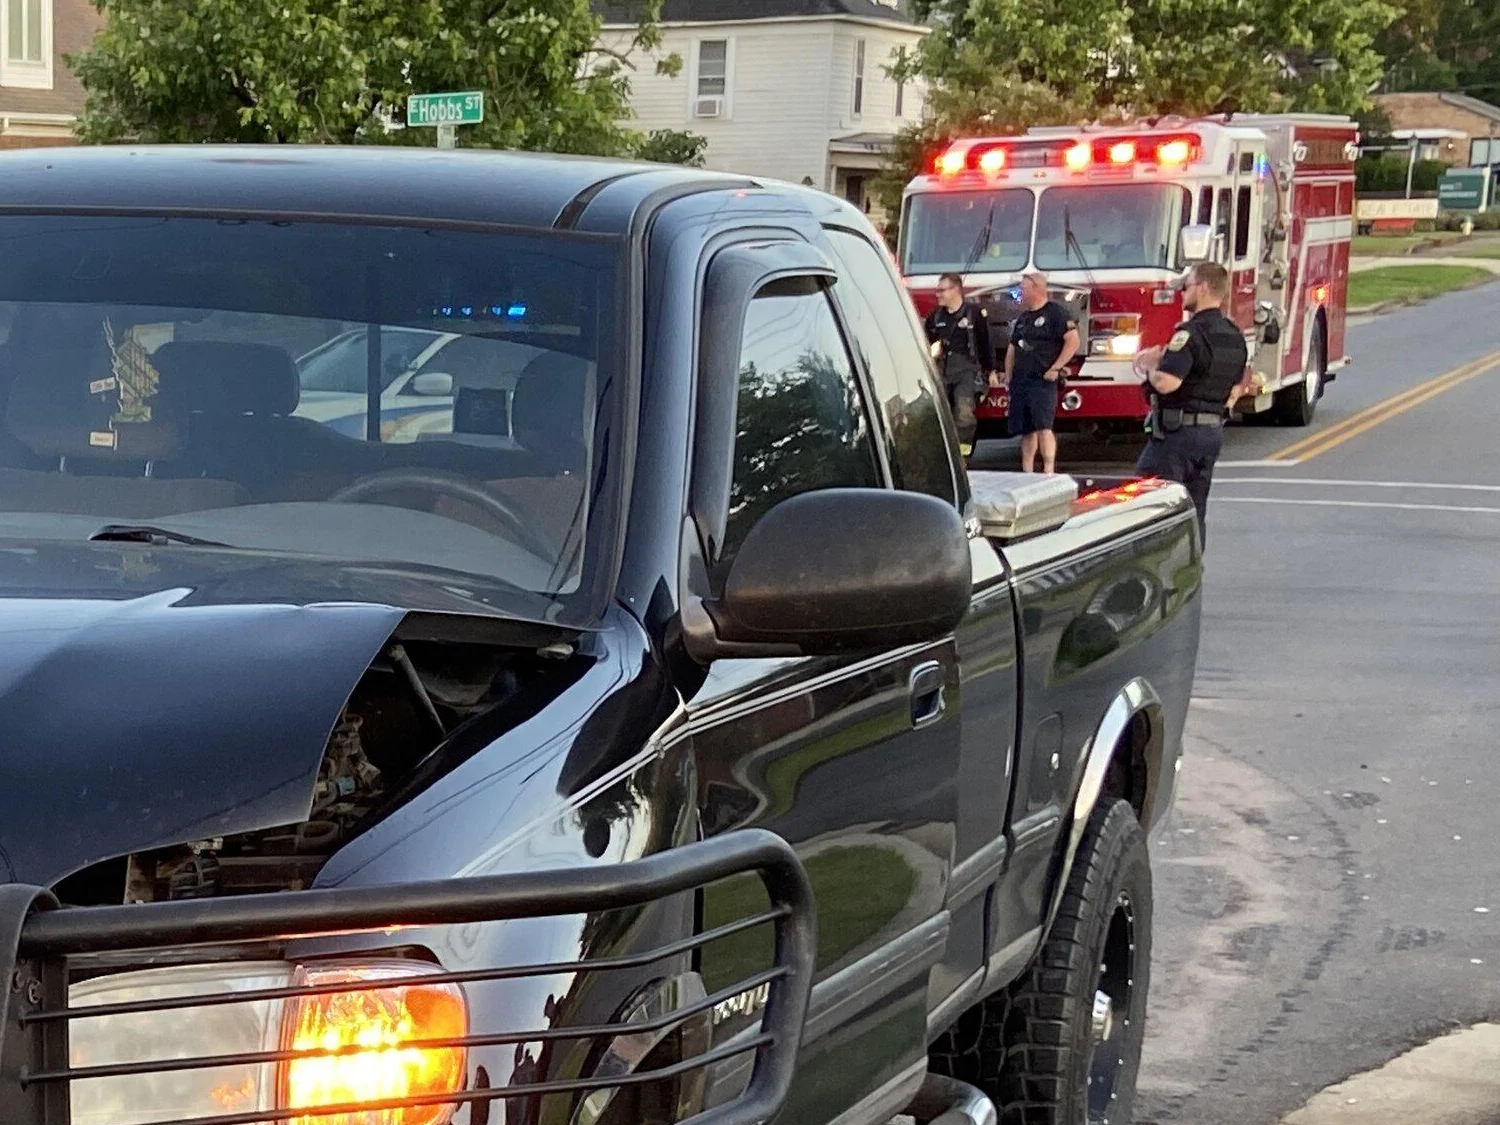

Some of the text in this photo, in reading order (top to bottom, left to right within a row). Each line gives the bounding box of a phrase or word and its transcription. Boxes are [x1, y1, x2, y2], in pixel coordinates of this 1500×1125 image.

[410, 96, 480, 121] E Hobbs ST
